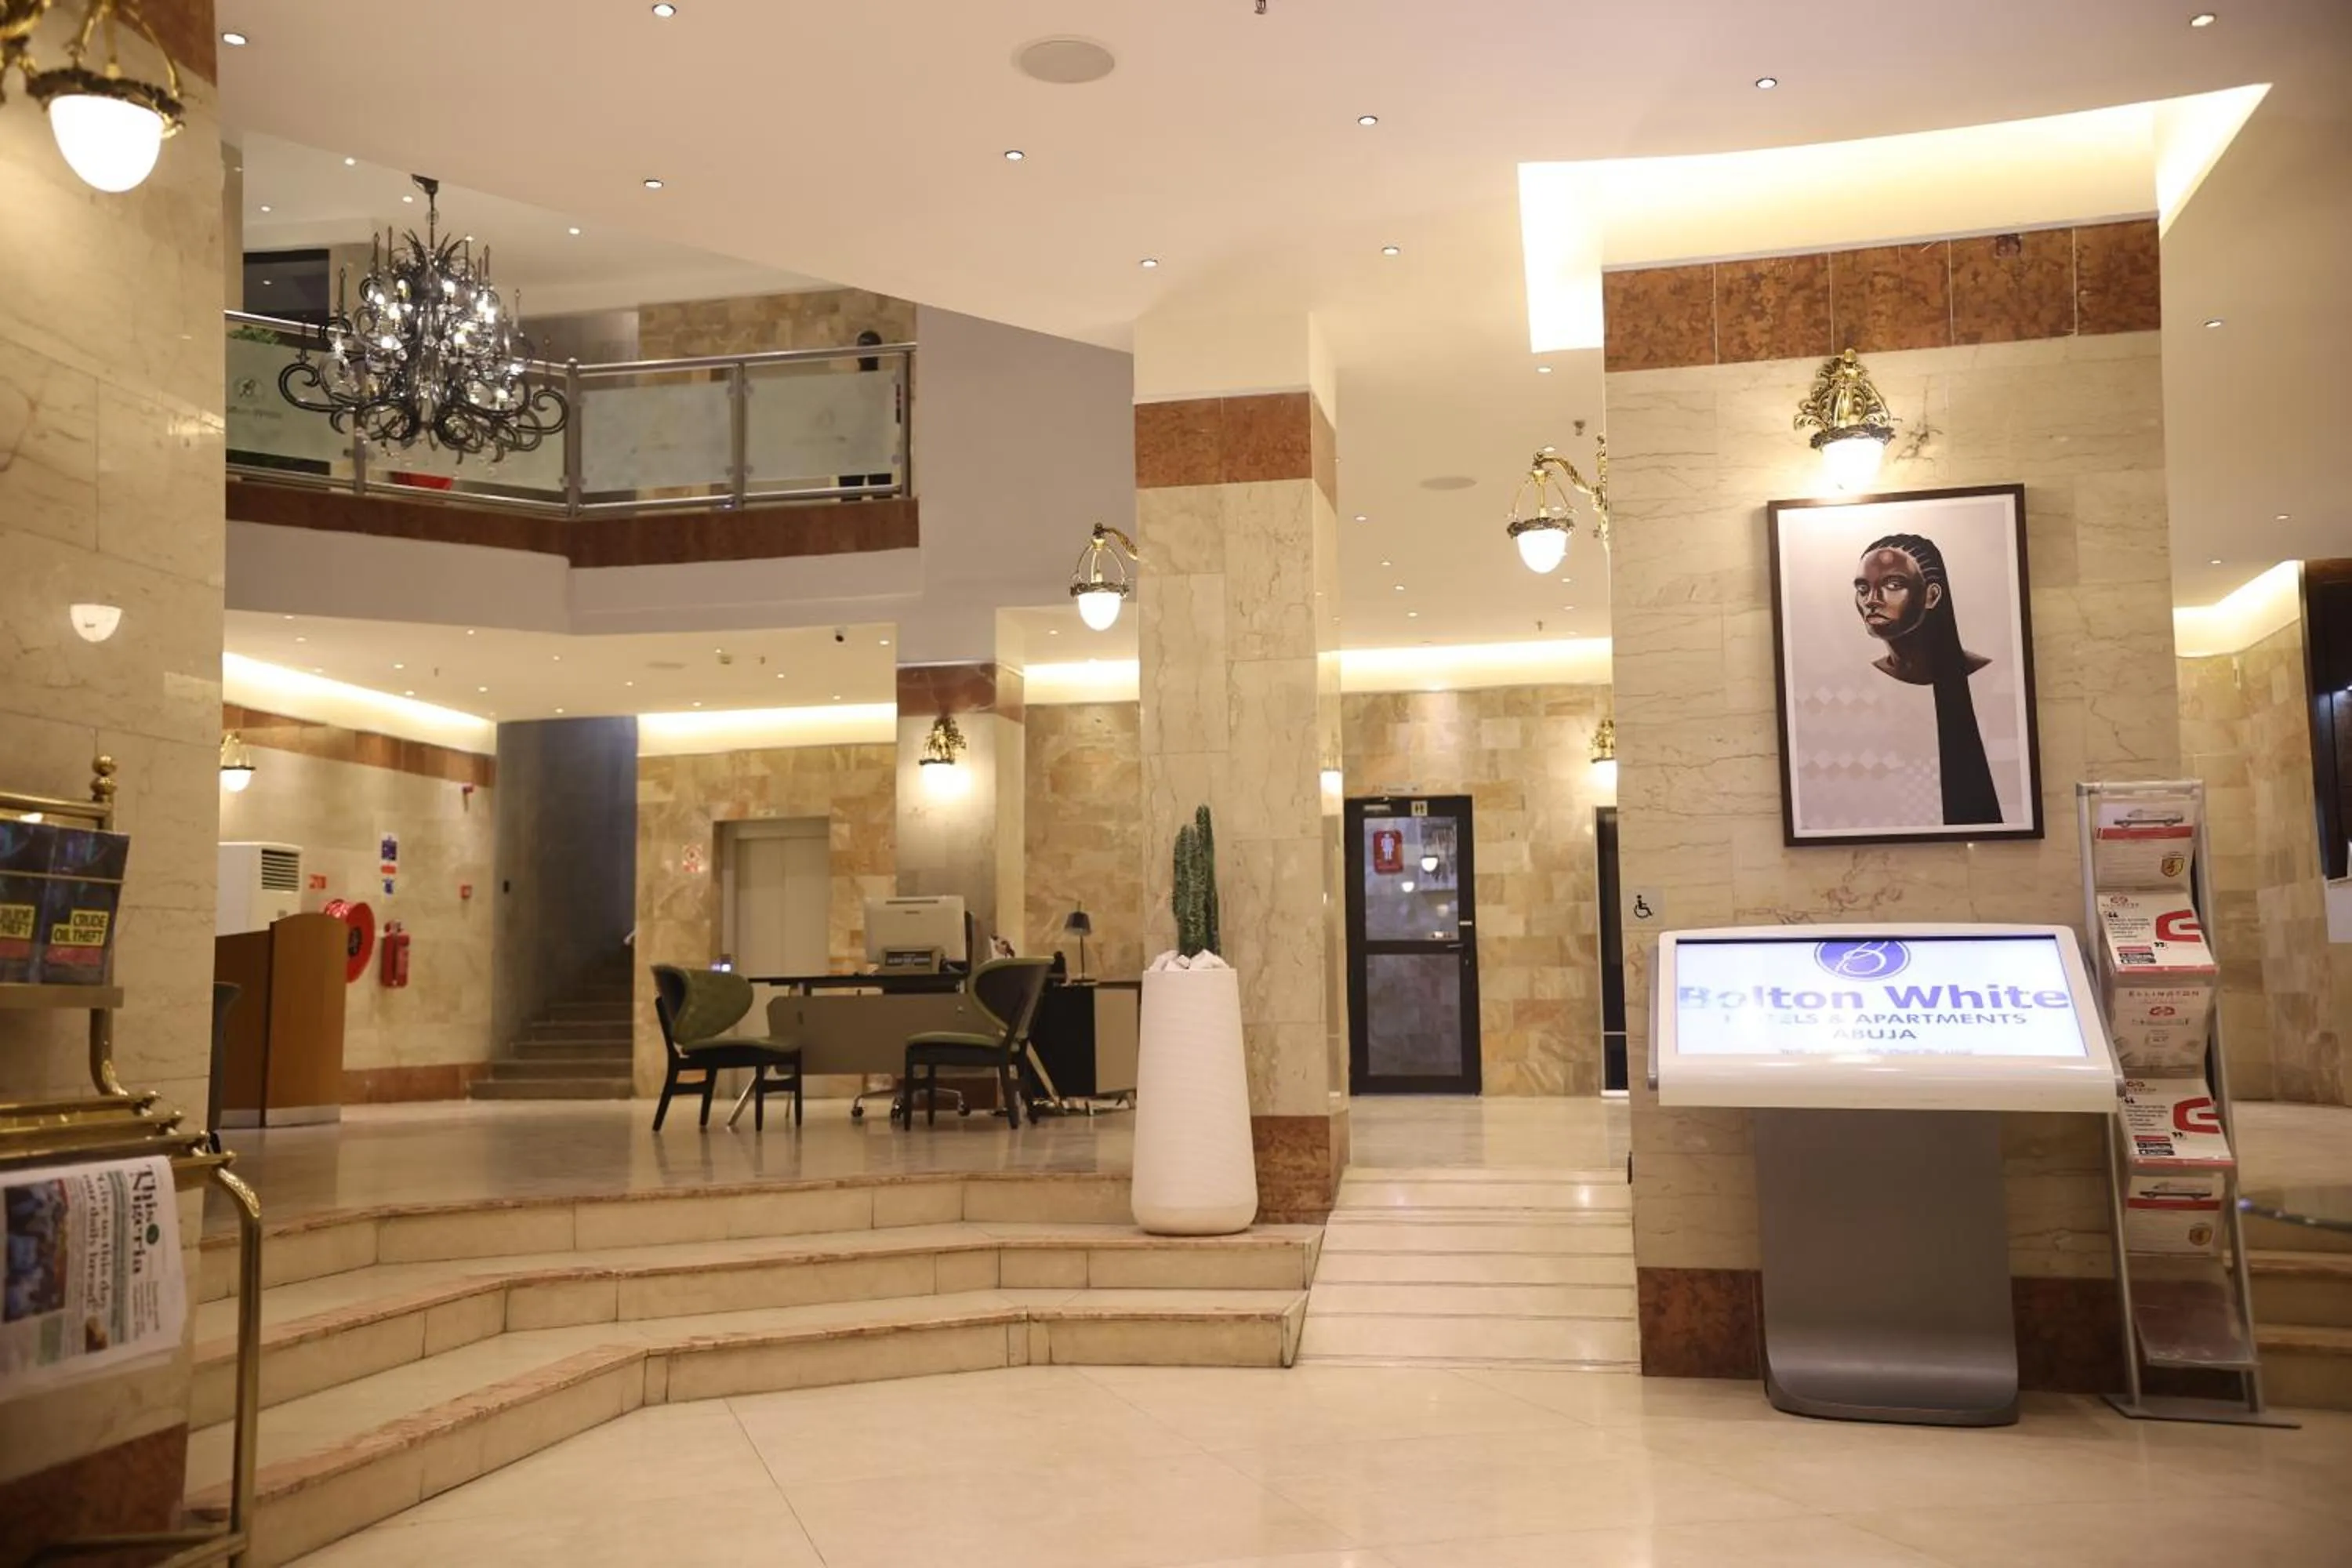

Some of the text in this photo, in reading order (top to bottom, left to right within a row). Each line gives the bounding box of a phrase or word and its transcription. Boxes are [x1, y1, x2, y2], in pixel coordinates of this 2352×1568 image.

[74, 913, 107, 927] CRUDE
[1679, 984, 2069, 1010] Bolton White
[1855, 1012, 2027, 1025] APARTMENTS
[1833, 1027, 1918, 1040] ABUJA
[130, 1171, 147, 1274] Nigeria
